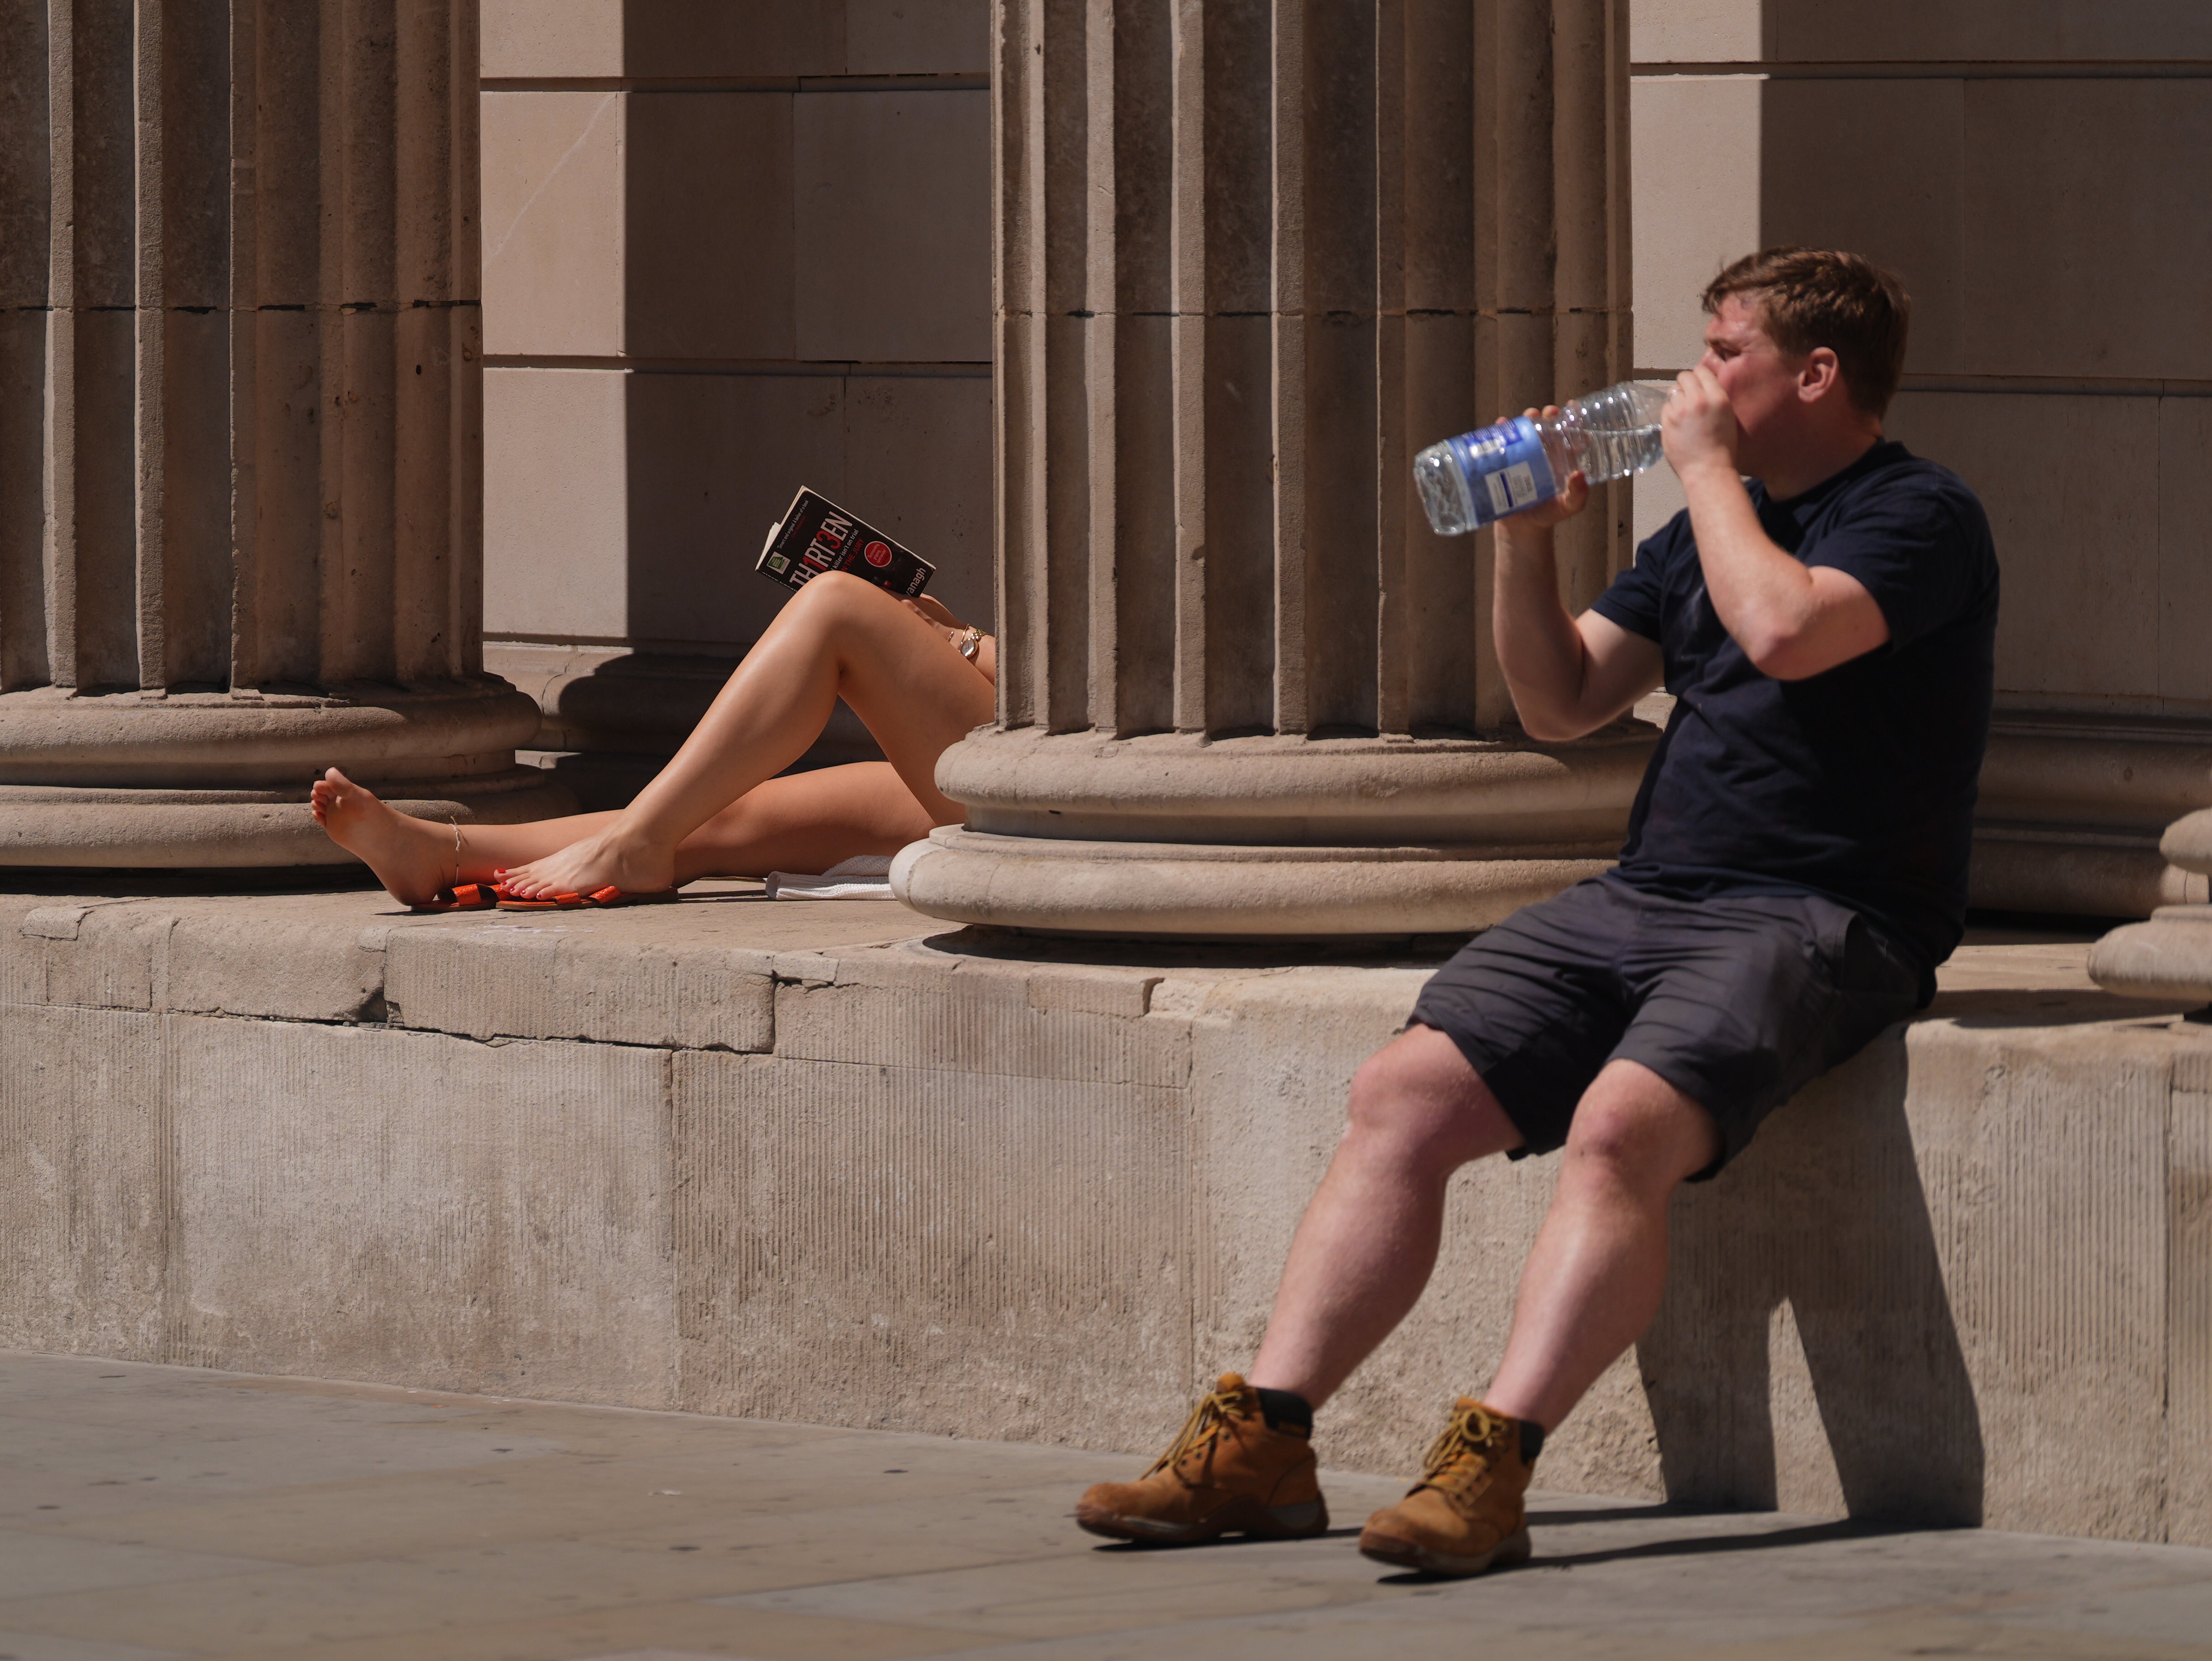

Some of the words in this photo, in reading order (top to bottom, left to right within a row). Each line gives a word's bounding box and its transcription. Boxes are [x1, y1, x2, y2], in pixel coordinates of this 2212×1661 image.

[789, 511, 853, 585] TH1RT3EN
[832, 555, 843, 569] killer
[840, 545, 849, 556] isn't
[850, 529, 859, 539] trial
[844, 553, 856, 566] THE
[852, 538, 864, 554] JURY
